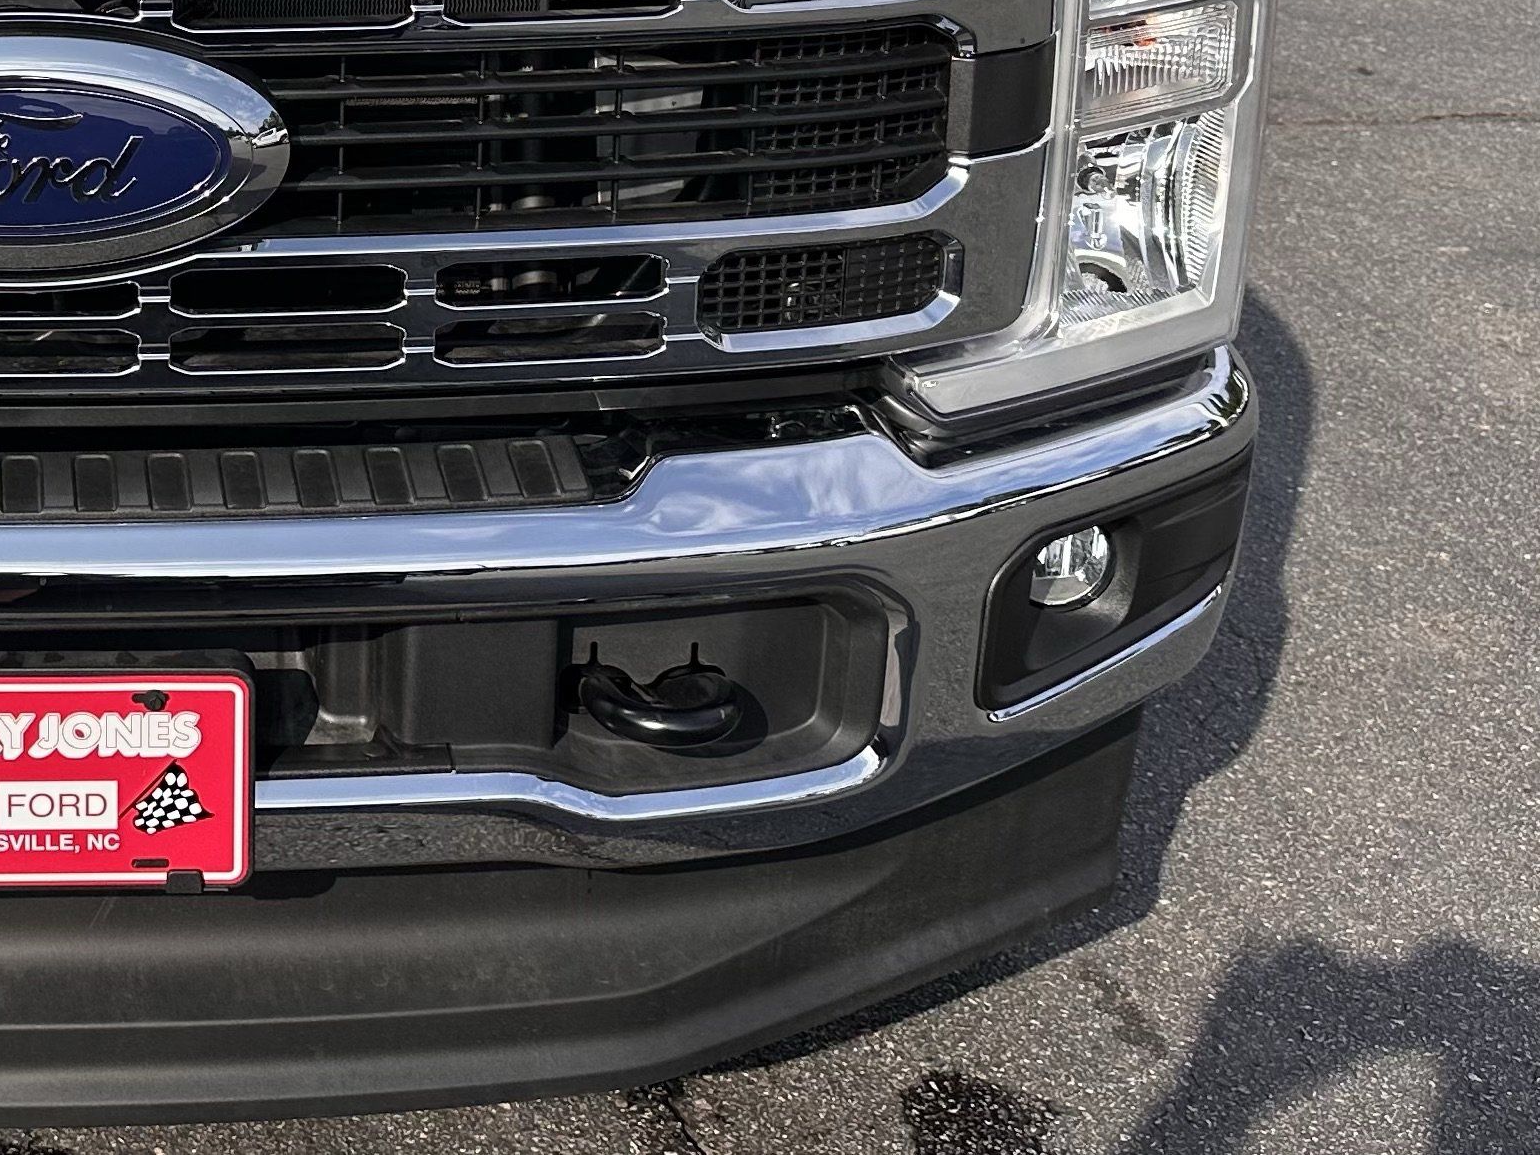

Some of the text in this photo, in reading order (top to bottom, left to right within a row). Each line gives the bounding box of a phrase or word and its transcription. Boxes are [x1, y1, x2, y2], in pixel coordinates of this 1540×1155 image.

[29, 711, 202, 759] JONES
[7, 793, 107, 817] FORD
[88, 833, 120, 851] NC
